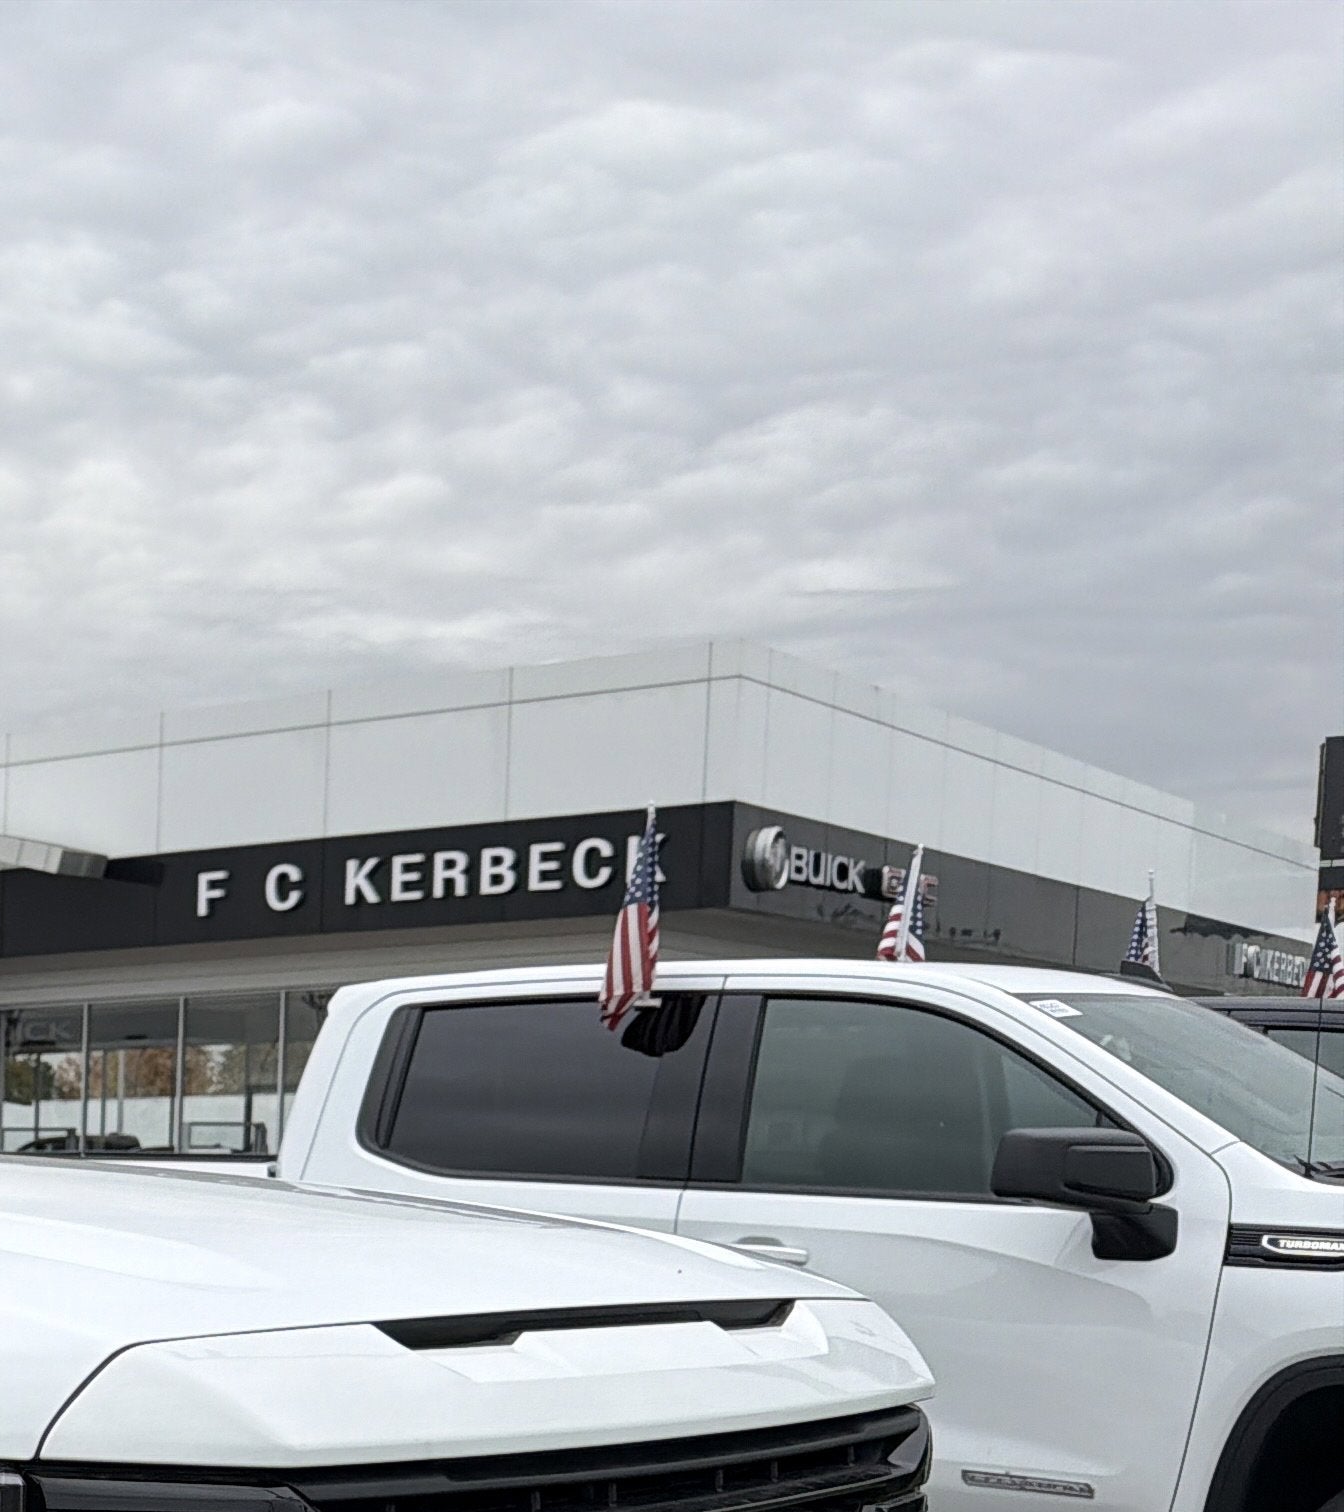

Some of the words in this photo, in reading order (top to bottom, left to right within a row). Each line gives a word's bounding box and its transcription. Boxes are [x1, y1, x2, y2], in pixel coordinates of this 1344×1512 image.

[194, 870, 231, 918] F
[262, 862, 304, 913] C
[789, 845, 866, 894] BUICK
[881, 864, 939, 907] GC
